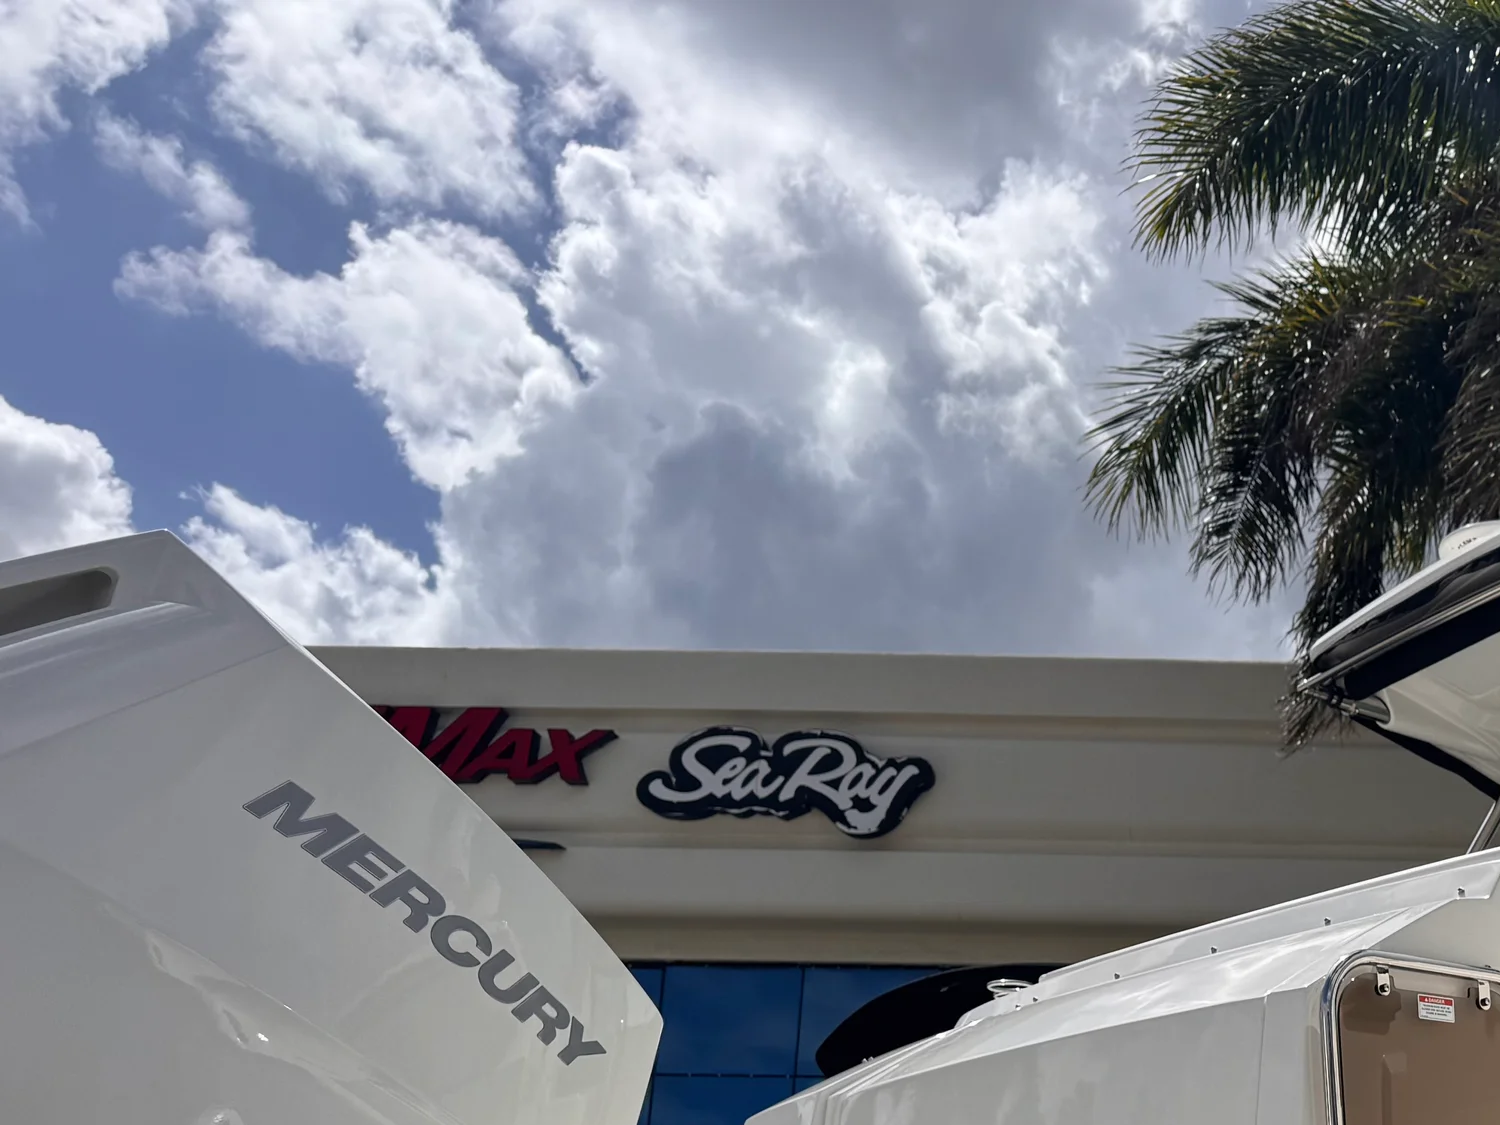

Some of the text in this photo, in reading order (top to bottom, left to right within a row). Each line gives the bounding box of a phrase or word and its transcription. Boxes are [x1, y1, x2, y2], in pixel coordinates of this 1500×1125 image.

[372, 706, 616, 785] MAX
[648, 734, 920, 833] Sea Ray
[242, 779, 607, 1066] MERCURY
